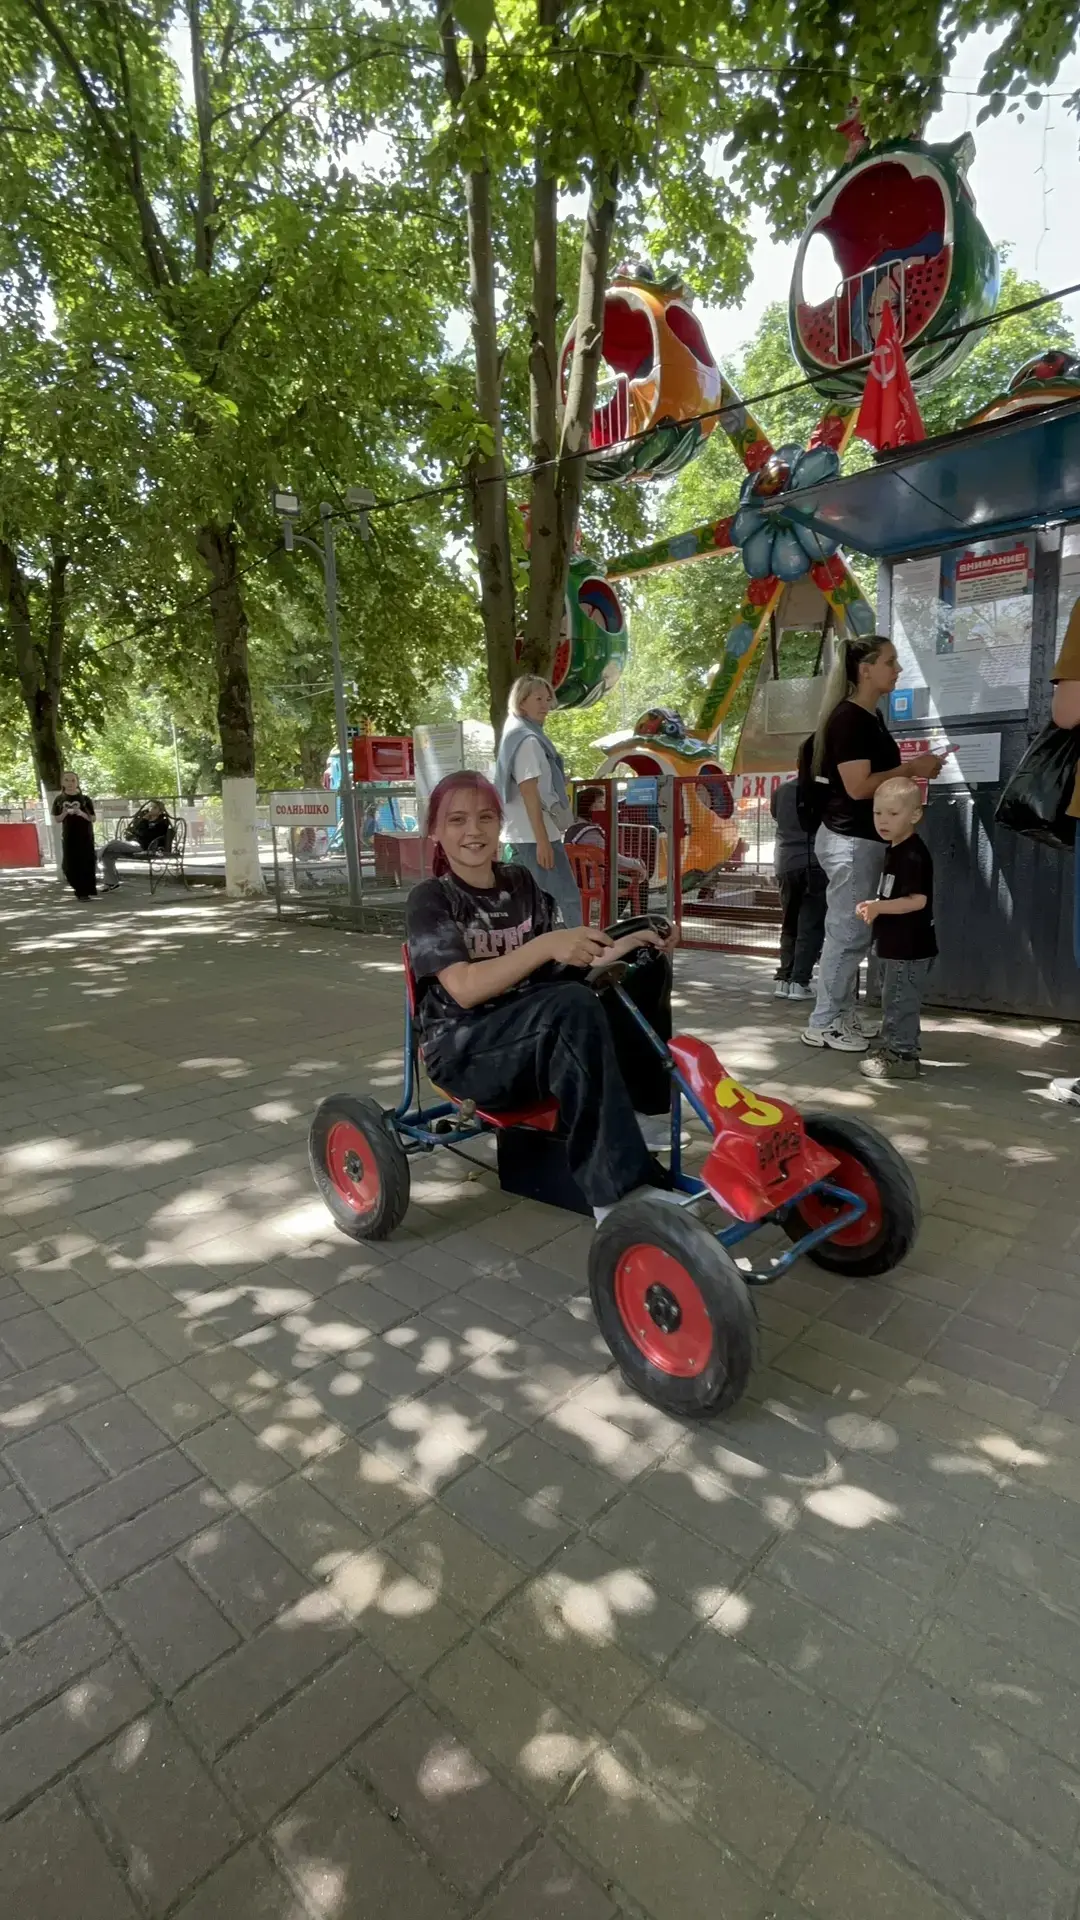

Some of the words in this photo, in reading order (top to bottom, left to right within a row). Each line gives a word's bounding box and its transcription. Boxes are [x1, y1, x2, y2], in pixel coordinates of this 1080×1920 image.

[959, 552, 1026, 572] ВНИМАНИЕ!
[742, 775, 797, 798] ВХО
[275, 804, 329, 815] СОЛНЫШКО
[715, 1076, 783, 1126] 3
